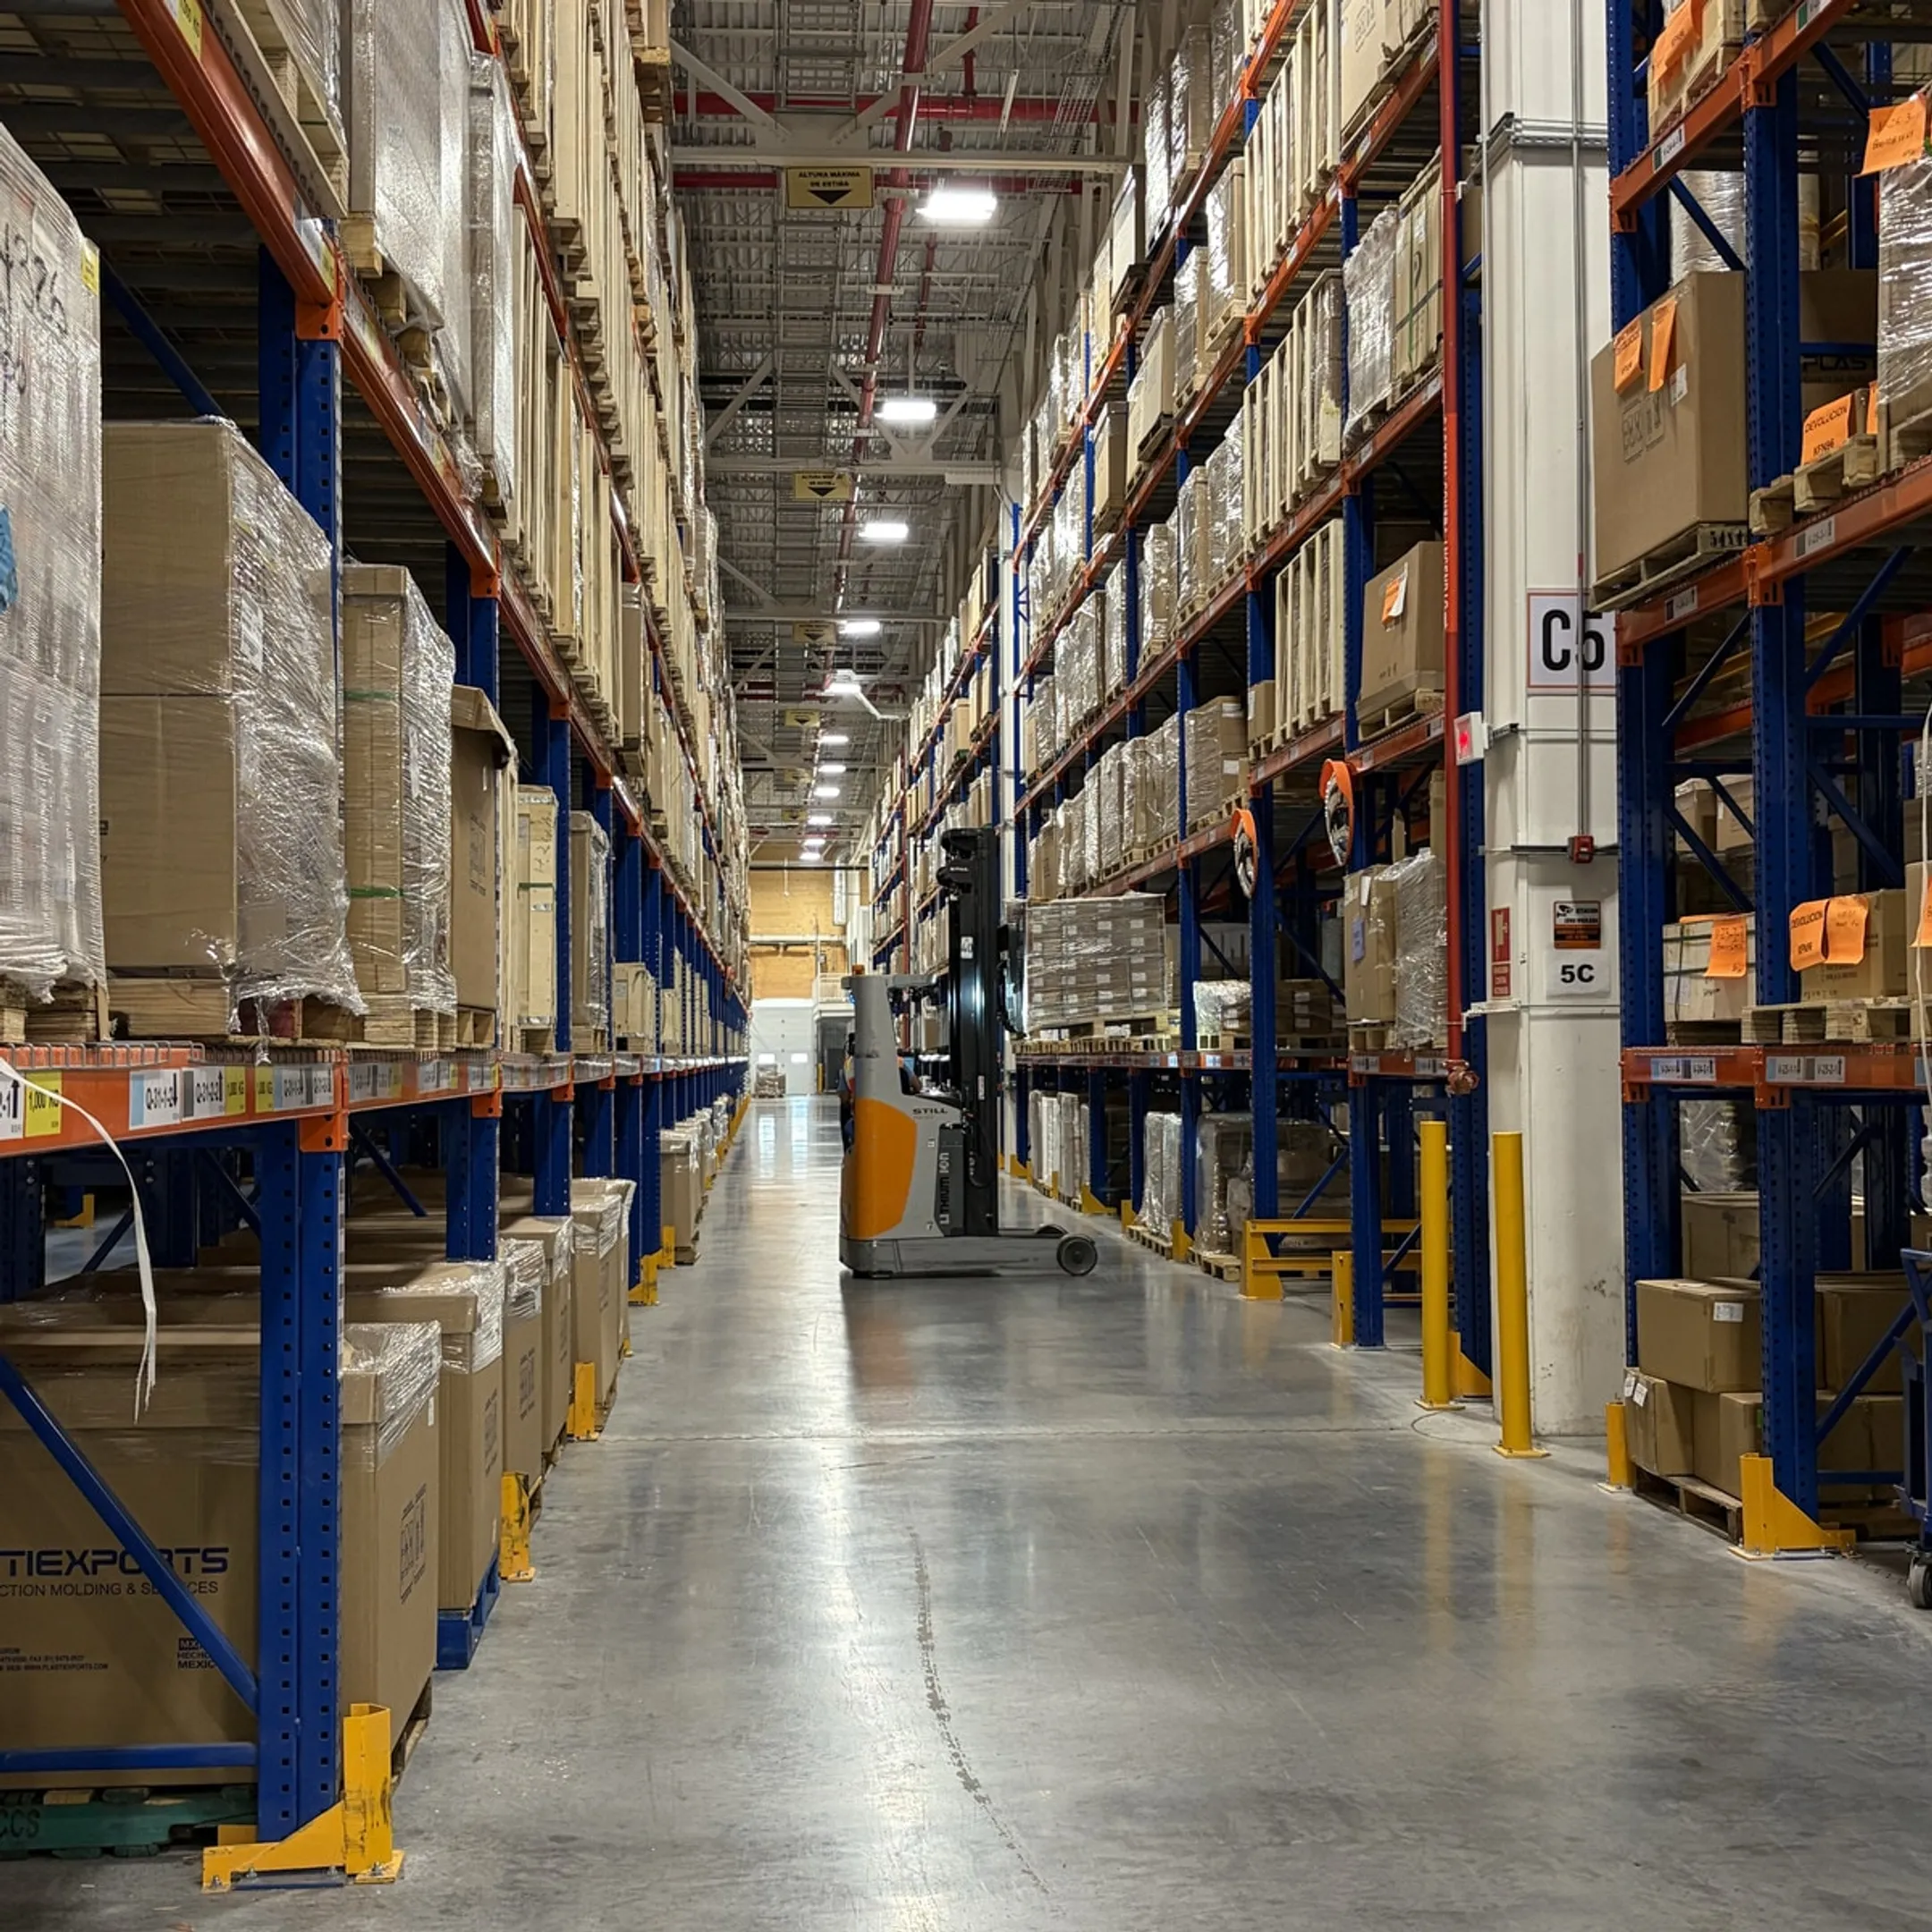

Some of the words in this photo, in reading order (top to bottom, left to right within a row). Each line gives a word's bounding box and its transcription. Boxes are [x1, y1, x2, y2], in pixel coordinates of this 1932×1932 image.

[1542, 609, 1606, 672] C5
[1560, 964, 1595, 984] 5C
[49, 1582, 122, 1597] MOLDING
[127, 1582, 136, 1596] &
